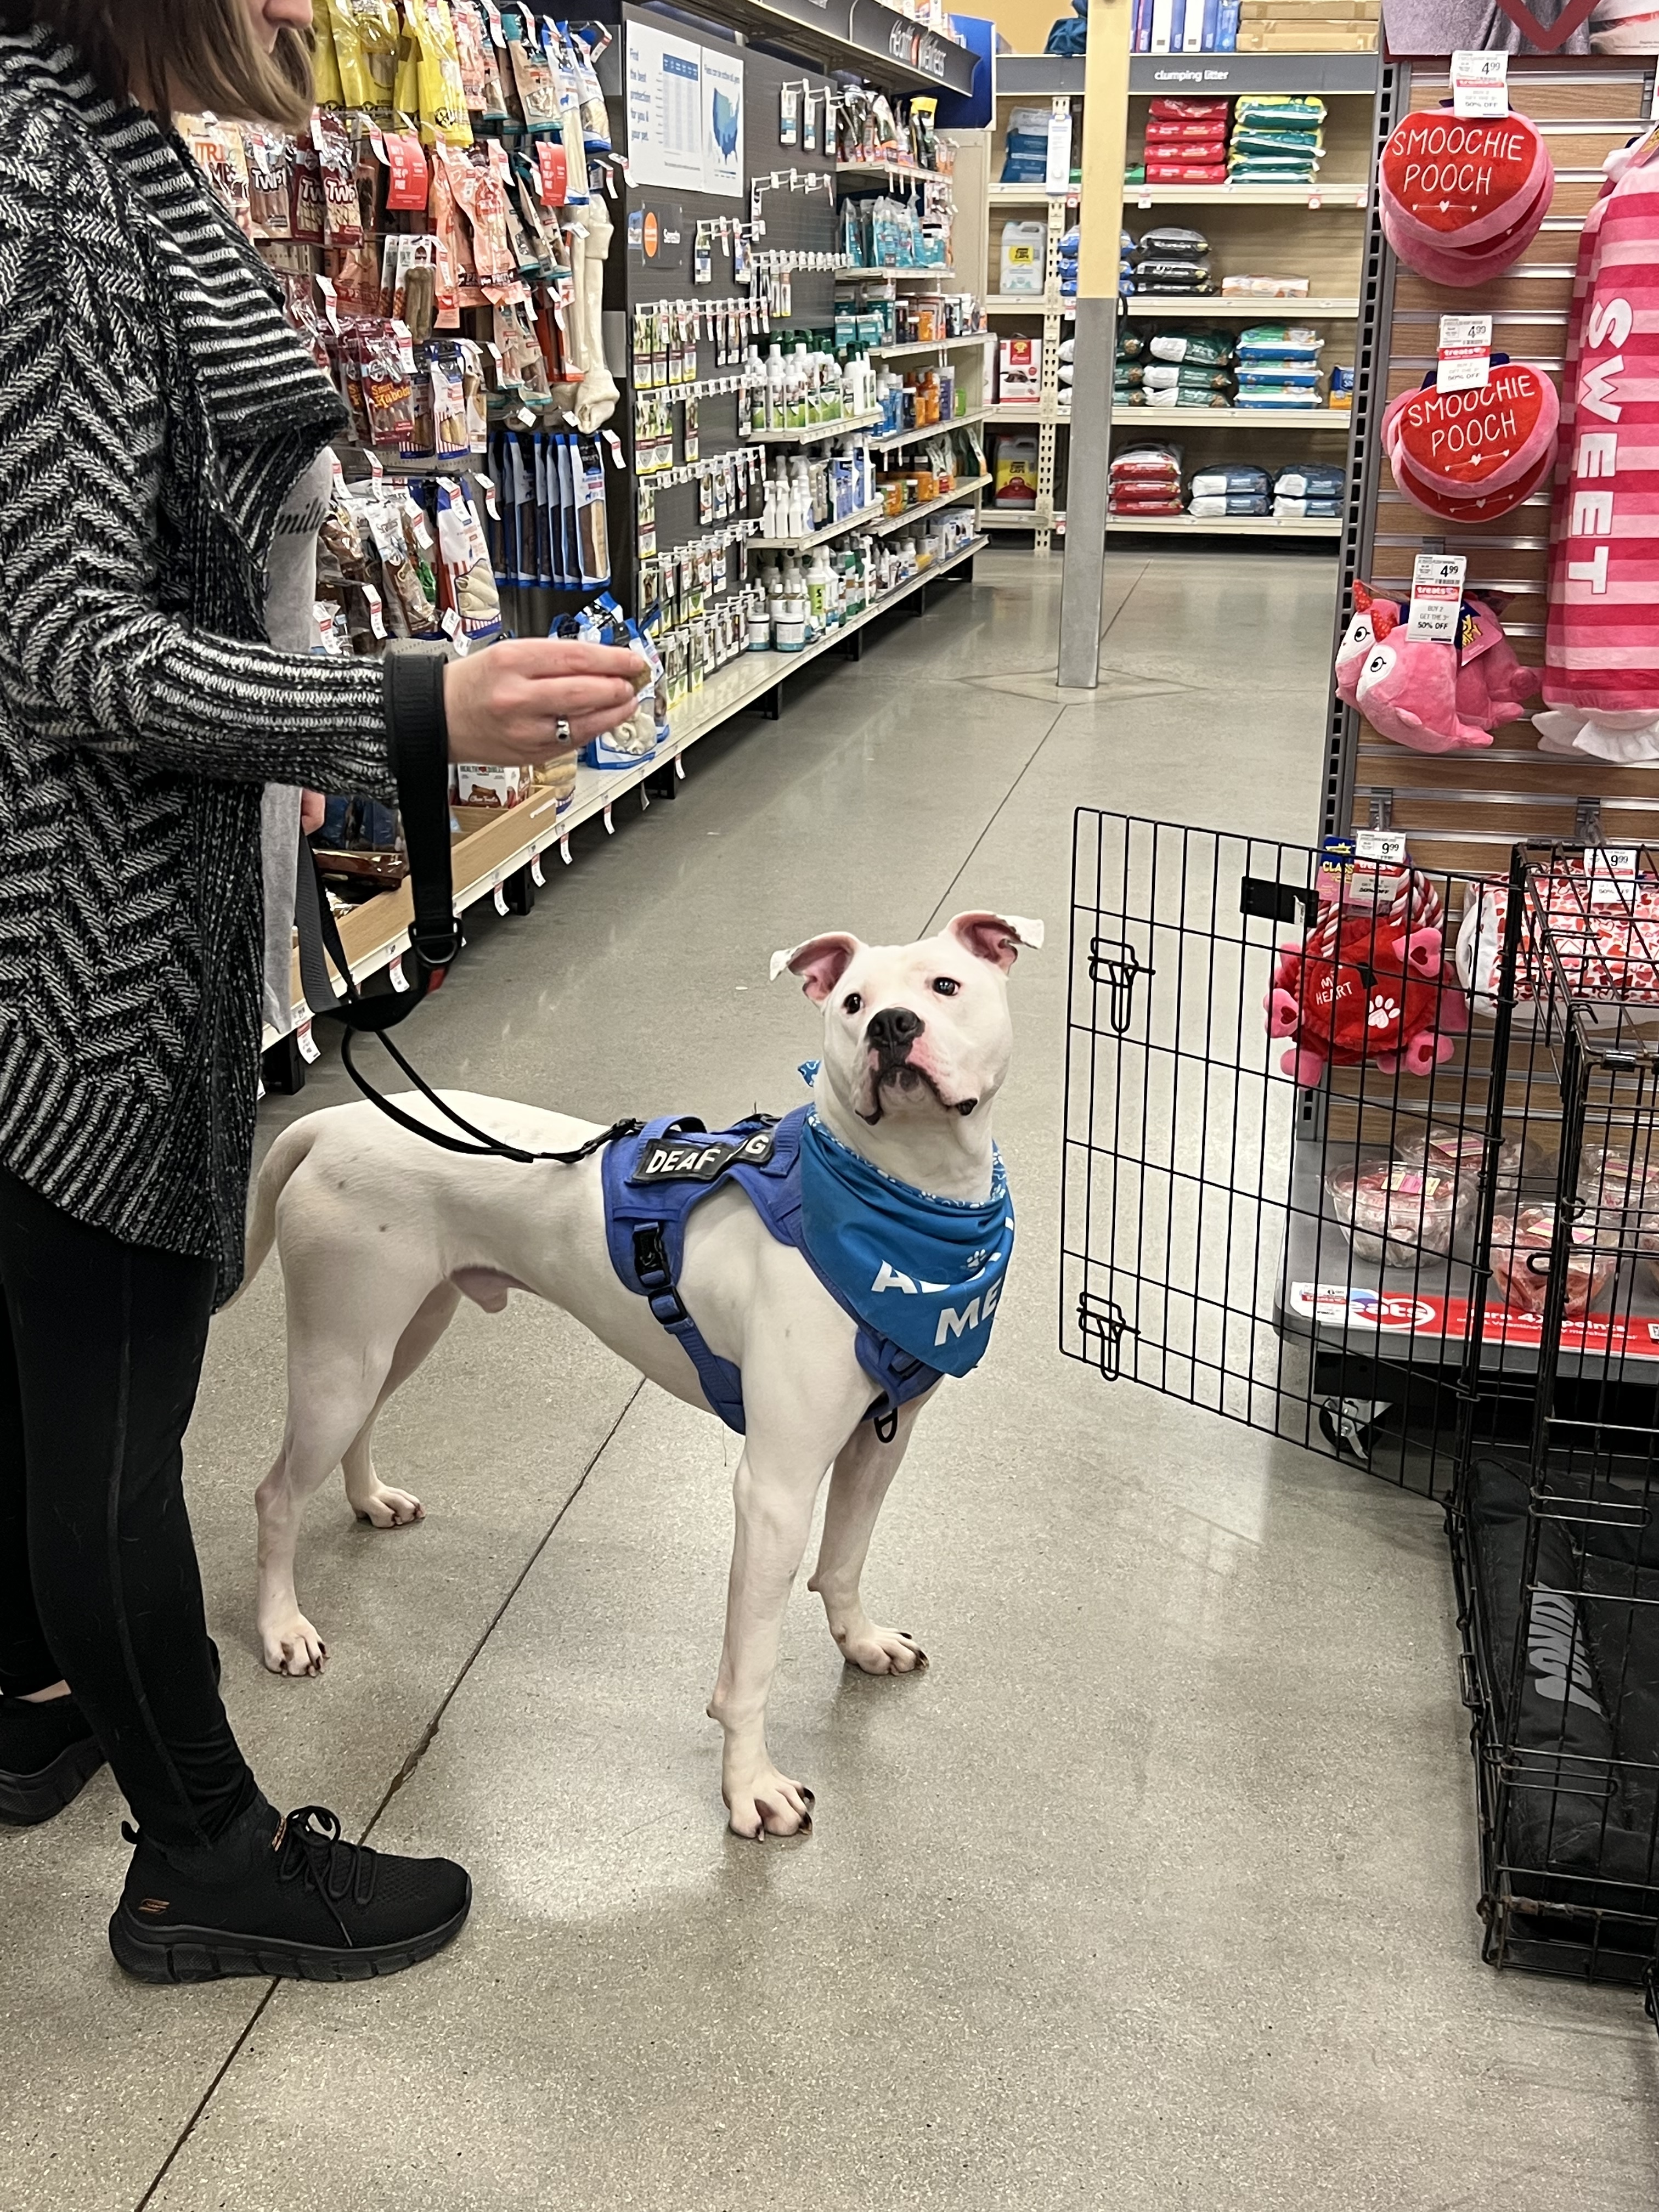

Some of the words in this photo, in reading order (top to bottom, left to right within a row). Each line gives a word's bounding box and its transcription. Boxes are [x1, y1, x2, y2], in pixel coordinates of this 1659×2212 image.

[1154, 70, 1203, 82] clumping
[1204, 70, 1229, 80] litter
[1392, 127, 1525, 161] SMOOCHIE
[1403, 163, 1492, 195] POOCH
[1408, 375, 1535, 427] SMOOCHIE
[1431, 409, 1516, 457] POOCH
[1567, 296, 1634, 595] SWEET
[1417, 586, 1446, 595] treats
[645, 1149, 721, 1174] DEAF
[934, 1276, 1002, 1347] ME
